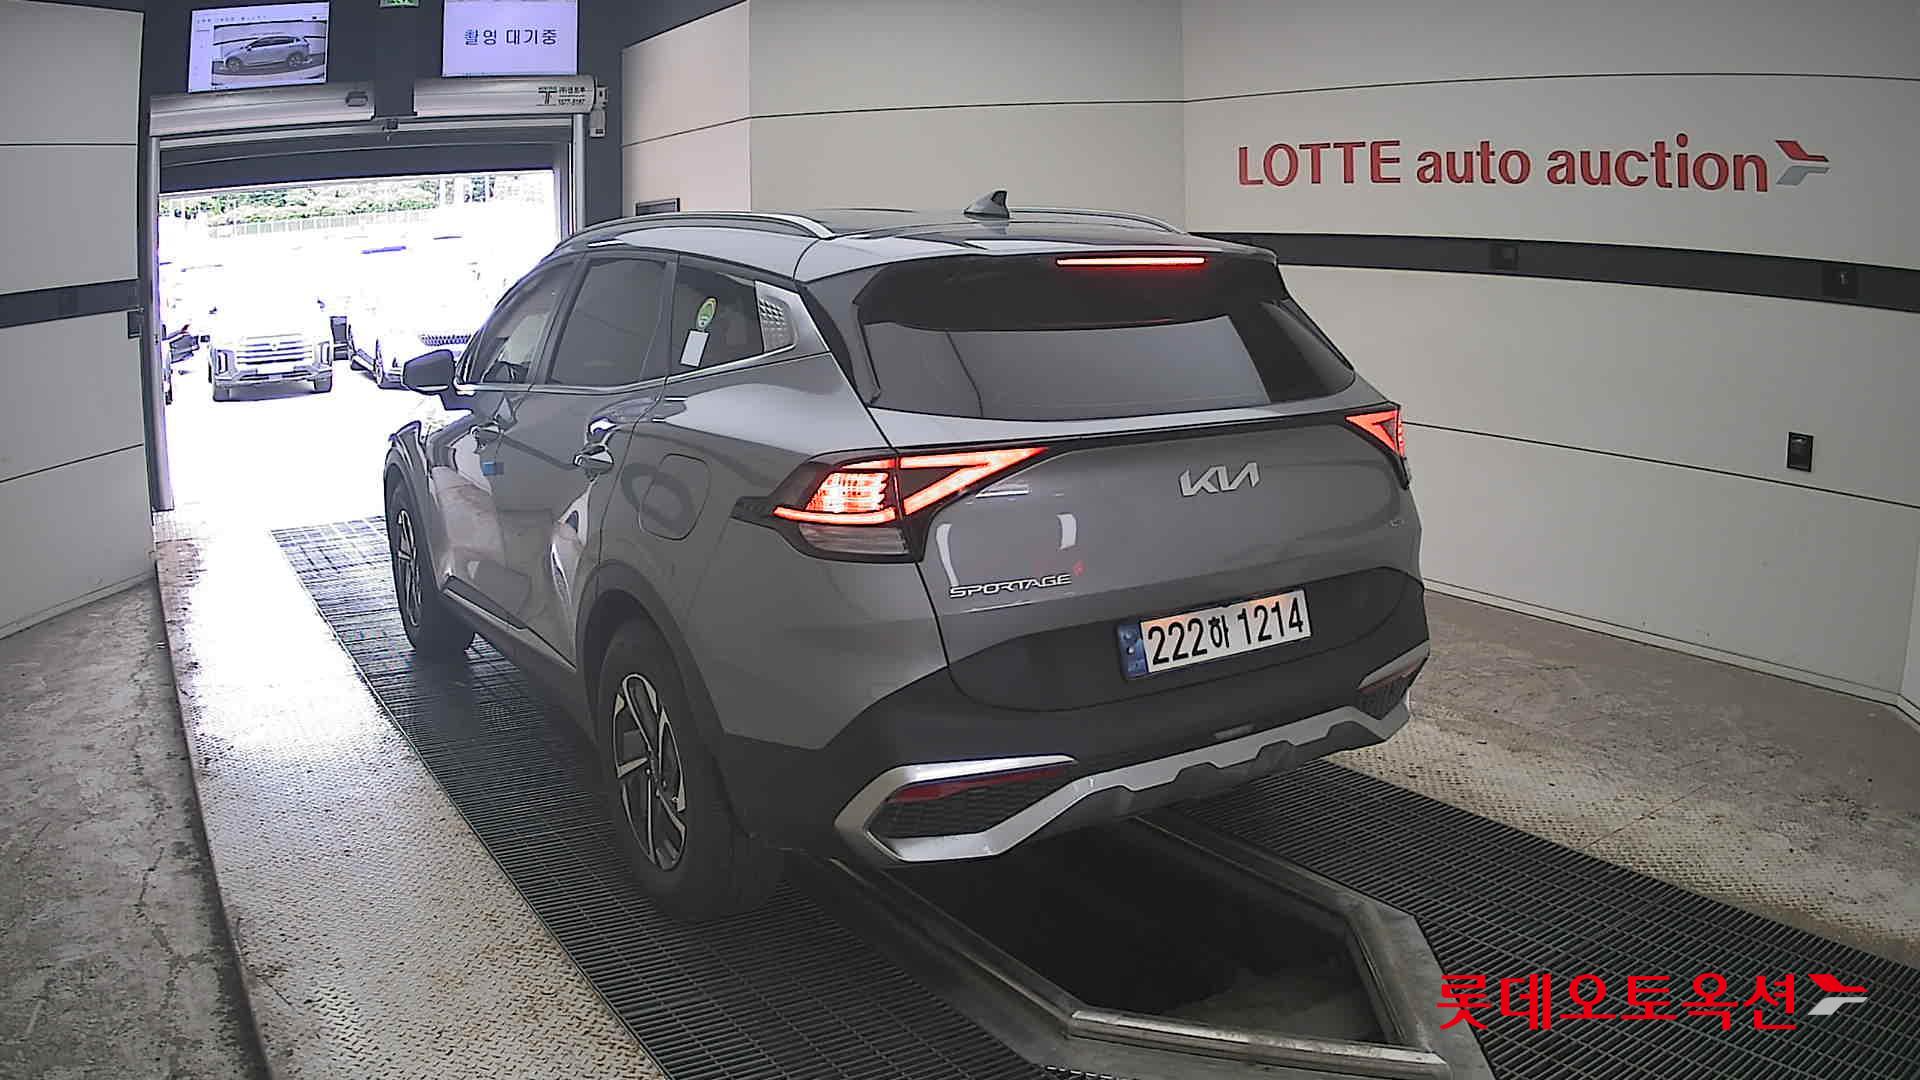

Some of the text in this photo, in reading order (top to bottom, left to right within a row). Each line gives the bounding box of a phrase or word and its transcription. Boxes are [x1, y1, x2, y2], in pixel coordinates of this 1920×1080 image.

[505, 29, 557, 45] 대기중
[1239, 133, 1768, 192] LOTTE auto auction
[1179, 462, 1260, 497] KIA
[950, 574, 1073, 599] SPORTAGE
[1148, 597, 1304, 666] 222하 1214
